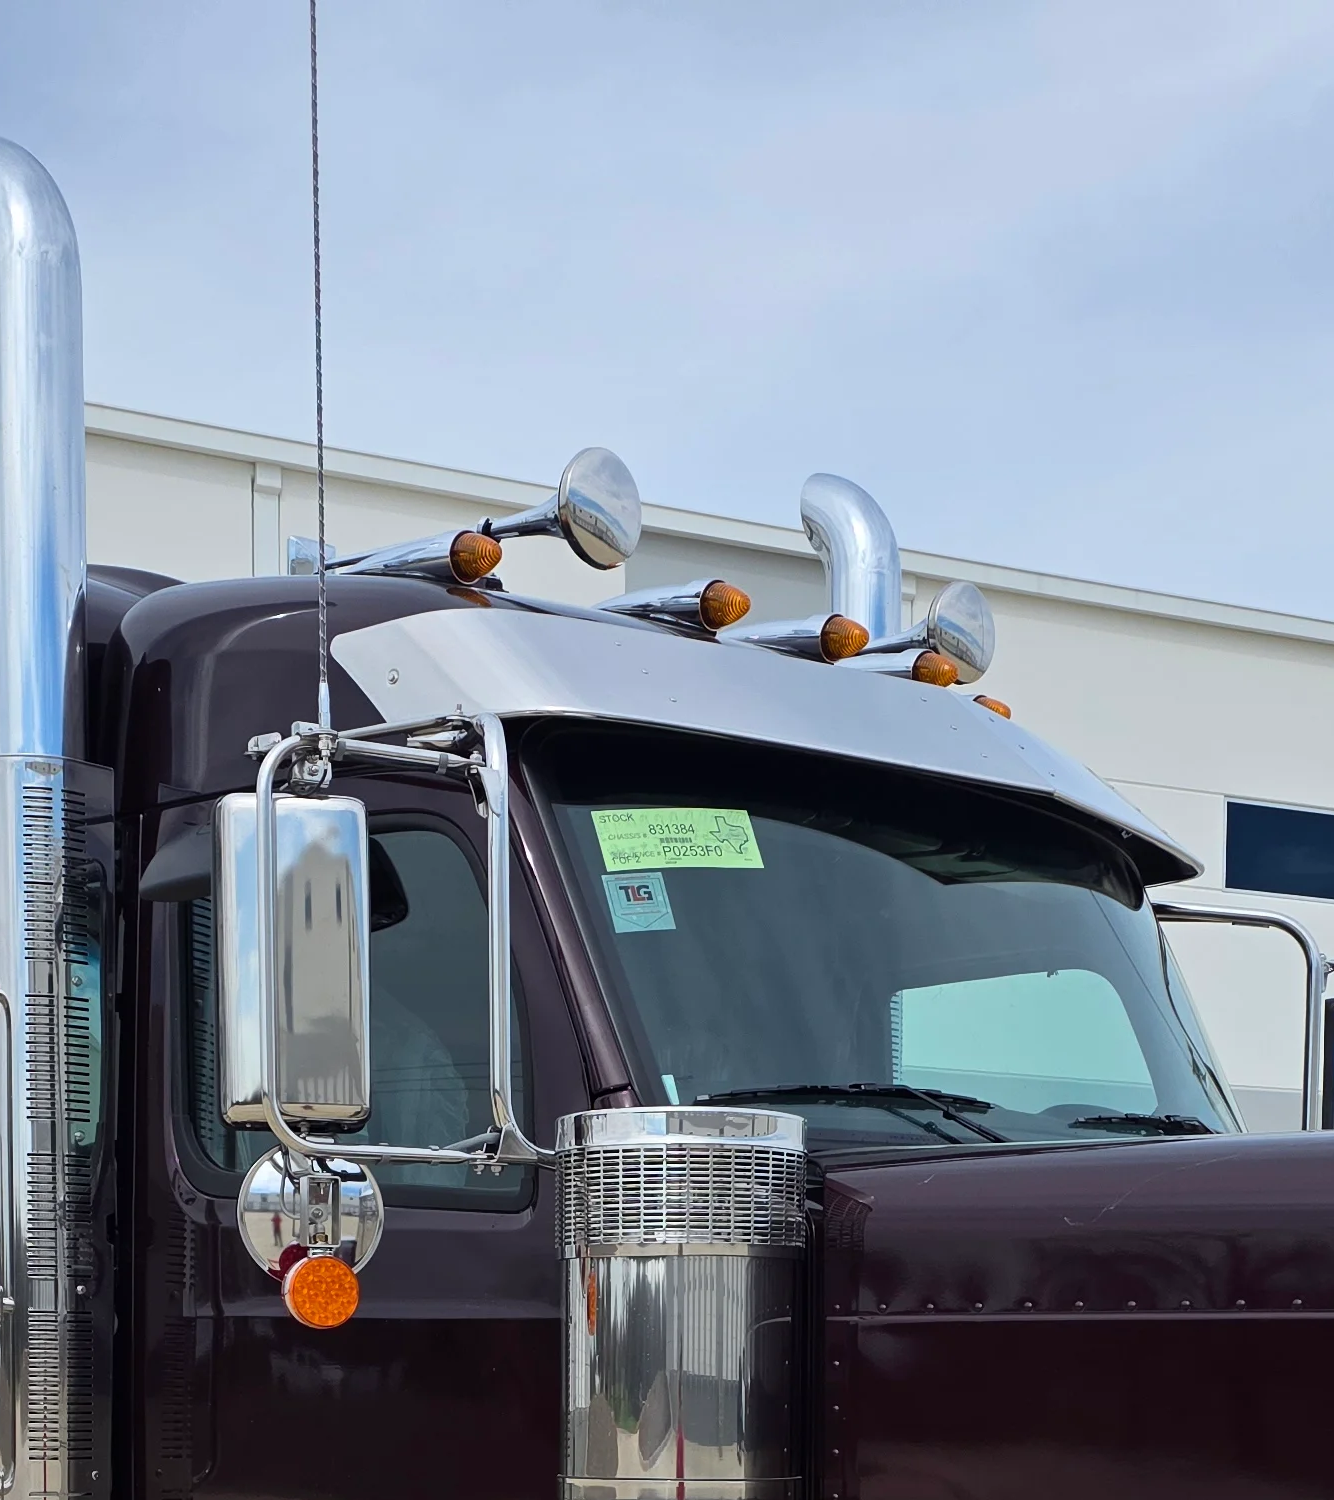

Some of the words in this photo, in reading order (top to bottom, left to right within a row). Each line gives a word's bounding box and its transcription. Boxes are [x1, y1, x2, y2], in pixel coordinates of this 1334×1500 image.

[599, 813, 636, 824] STOCK
[648, 824, 696, 835] 831384
[608, 832, 641, 840] CHASSIS
[662, 845, 723, 857] P0253F0
[618, 884, 654, 902] TLG
